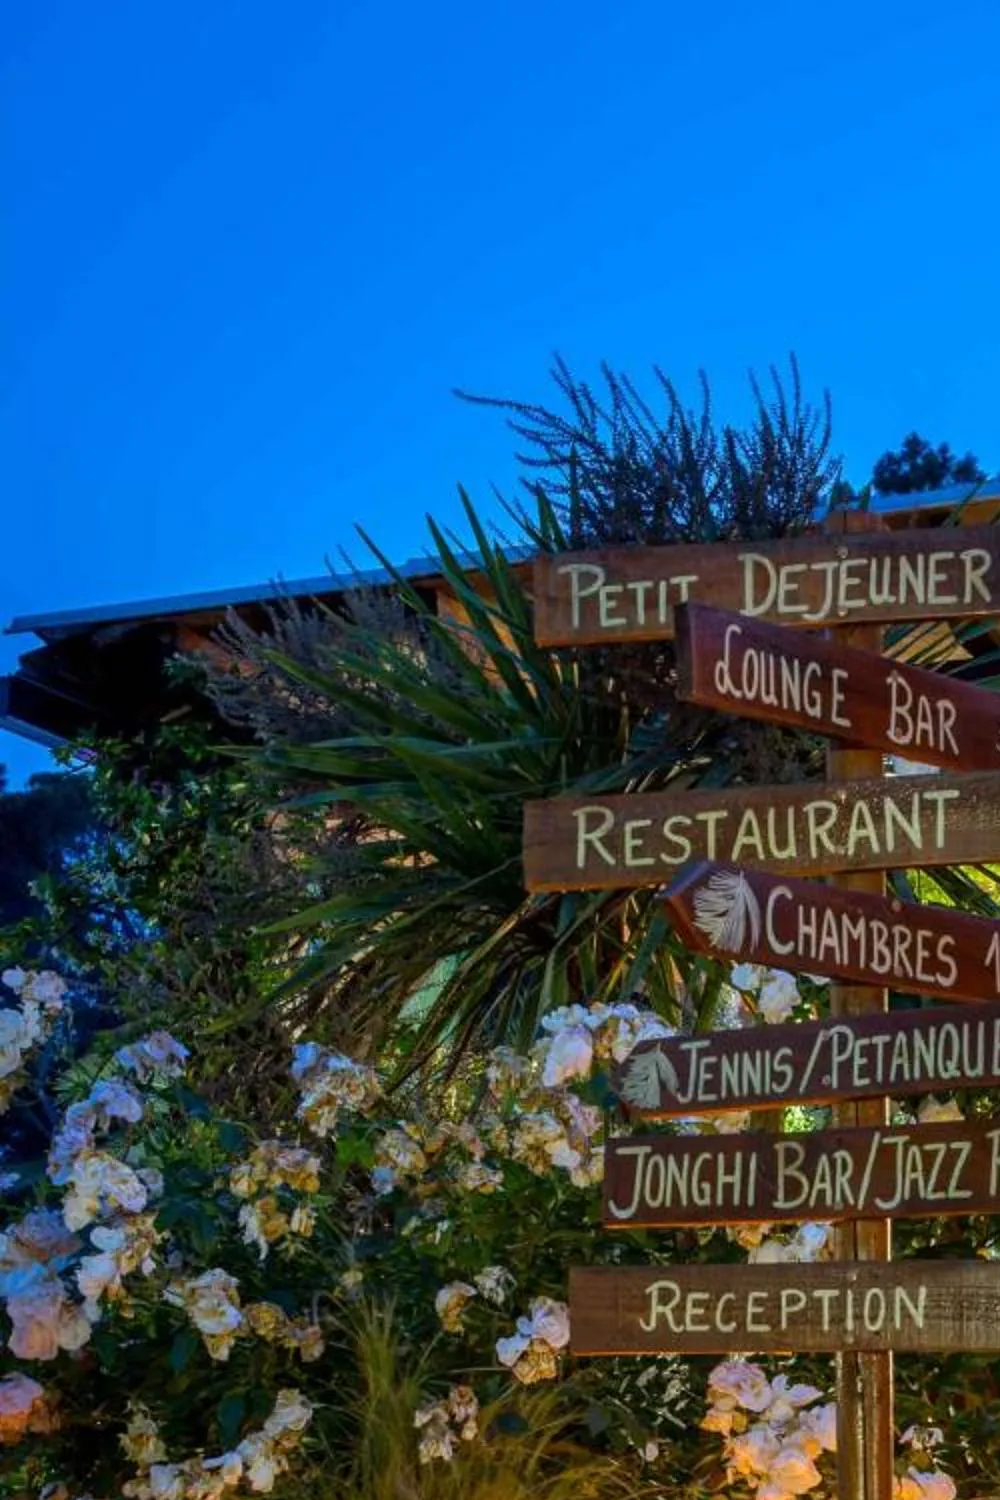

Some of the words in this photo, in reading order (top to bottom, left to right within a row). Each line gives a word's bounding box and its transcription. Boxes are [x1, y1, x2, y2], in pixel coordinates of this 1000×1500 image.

[557, 563, 699, 628] PETIT
[737, 549, 992, 621] DEJEUNER
[714, 623, 851, 728] LOUNGE
[886, 669, 960, 756] BAR
[573, 788, 960, 868] RESTAURANT
[765, 885, 959, 989] CHAMBRES
[984, 931, 1000, 993] 1
[638, 1279, 927, 1335] RECEPTION
